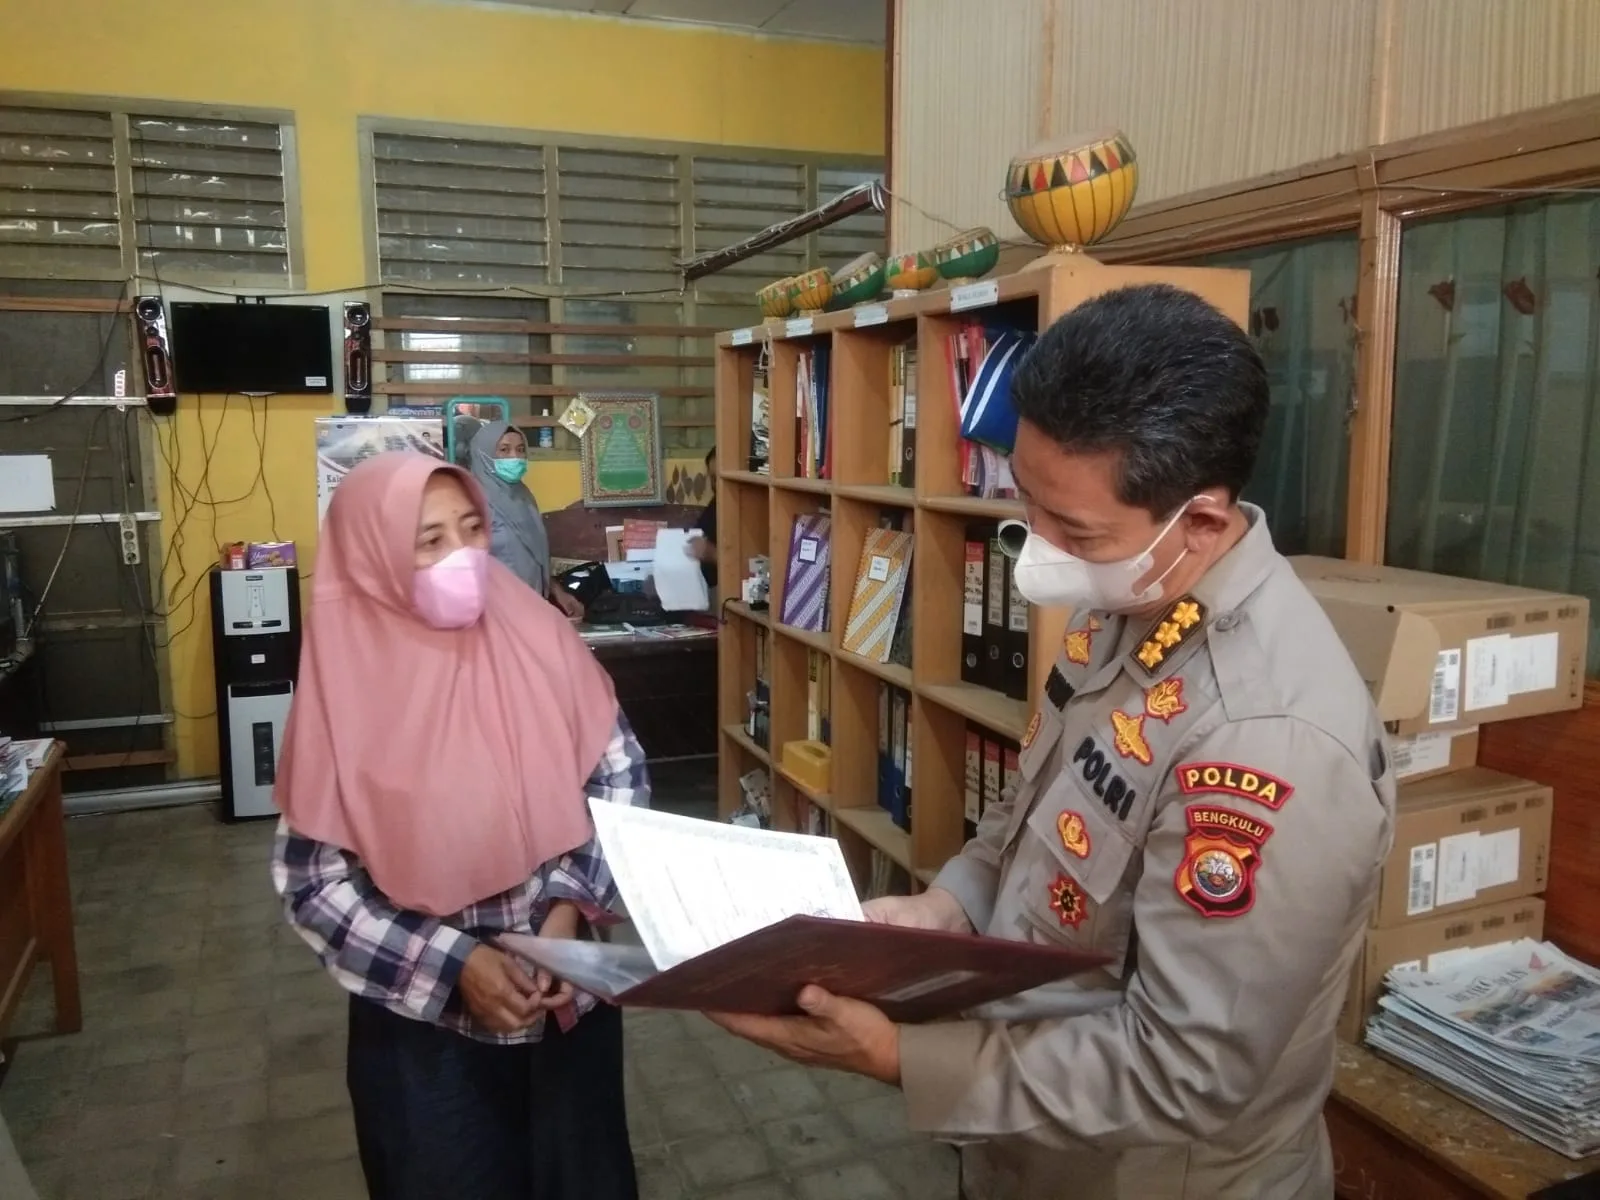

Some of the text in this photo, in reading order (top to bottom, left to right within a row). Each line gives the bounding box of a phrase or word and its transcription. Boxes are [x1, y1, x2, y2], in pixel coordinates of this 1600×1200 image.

[1073, 736, 1136, 821] POLRI
[1186, 767, 1277, 802] POLDA
[1194, 811, 1264, 837] BENGKULU
